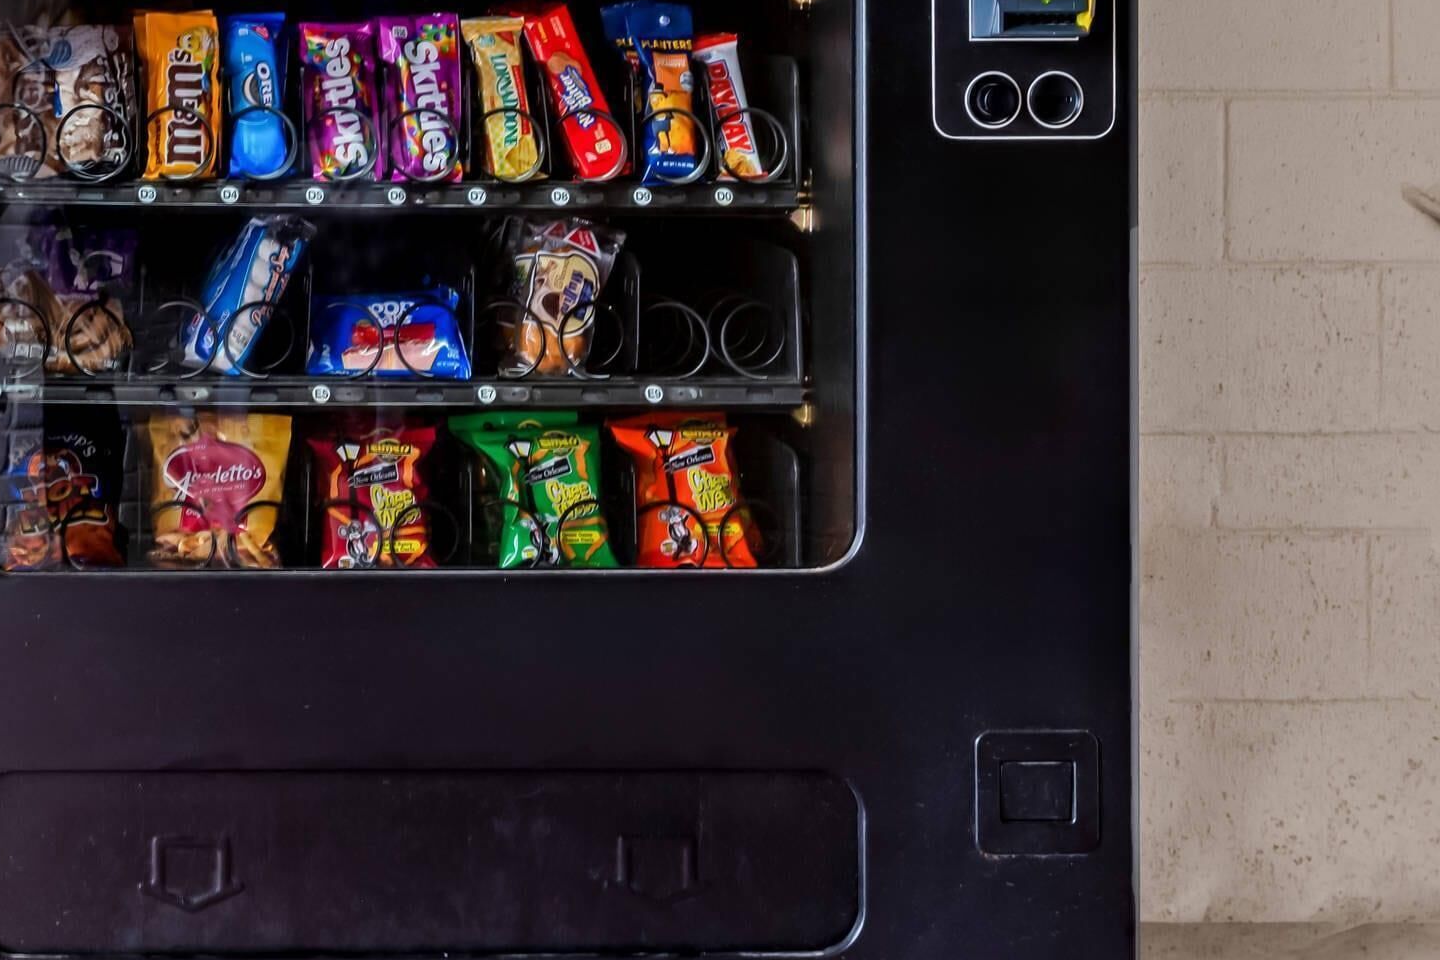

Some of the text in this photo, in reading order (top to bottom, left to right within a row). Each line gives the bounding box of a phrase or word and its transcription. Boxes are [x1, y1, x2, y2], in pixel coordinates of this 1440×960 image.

[256, 62, 274, 112] ORE
[322, 37, 368, 167] Skittles
[404, 40, 449, 173] Skittles
[708, 60, 756, 154] PAYDAY
[686, 453, 713, 465] Orleans
[370, 484, 414, 509] Chee
[545, 479, 591, 503] Chee
[687, 467, 732, 494] Chee
